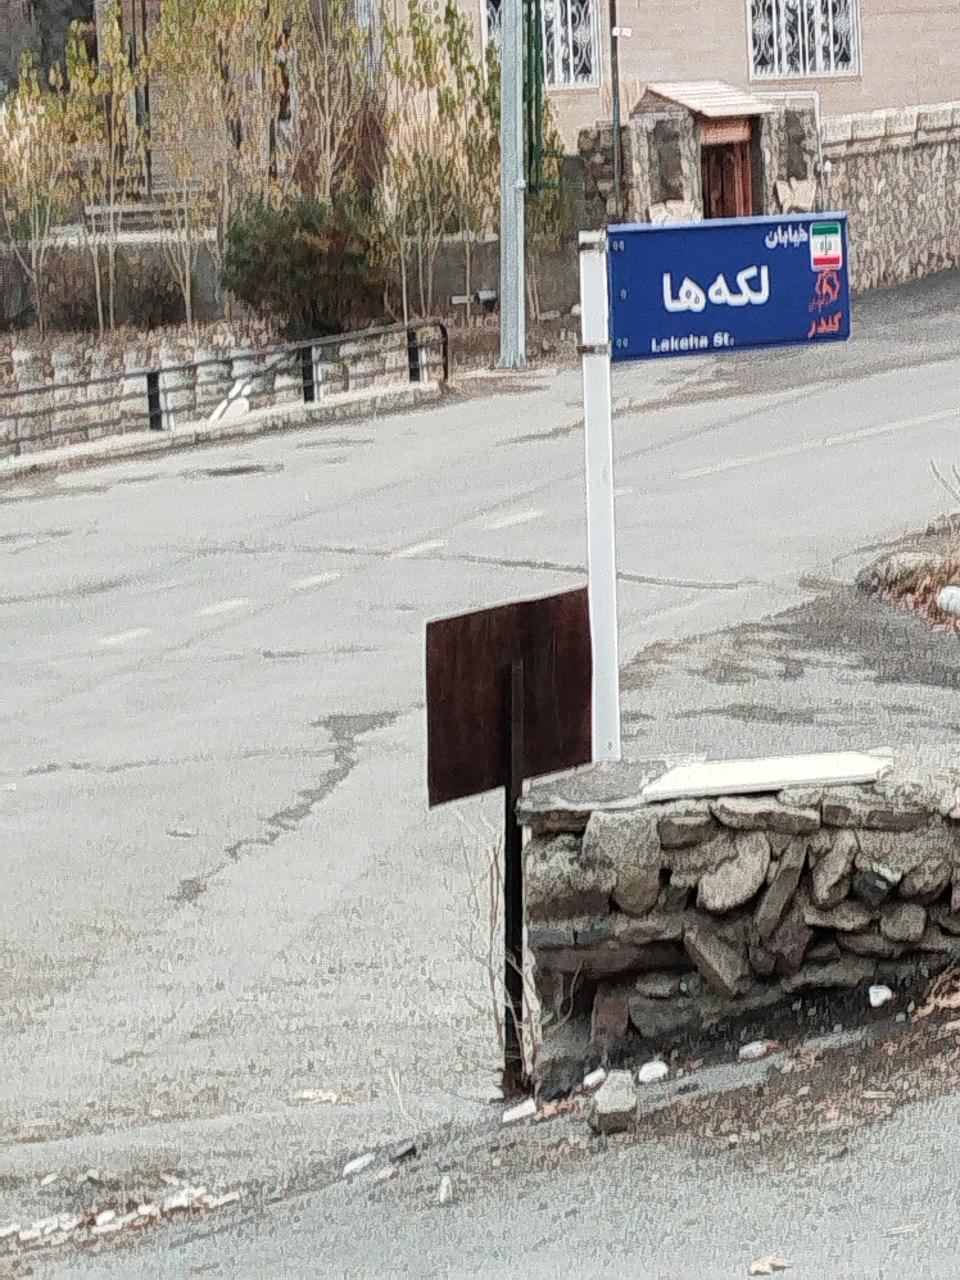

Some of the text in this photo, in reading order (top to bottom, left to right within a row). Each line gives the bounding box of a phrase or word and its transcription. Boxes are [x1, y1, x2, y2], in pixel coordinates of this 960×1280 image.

[765, 223, 808, 249] خیابان
[651, 331, 735, 353] Lakeha St.
